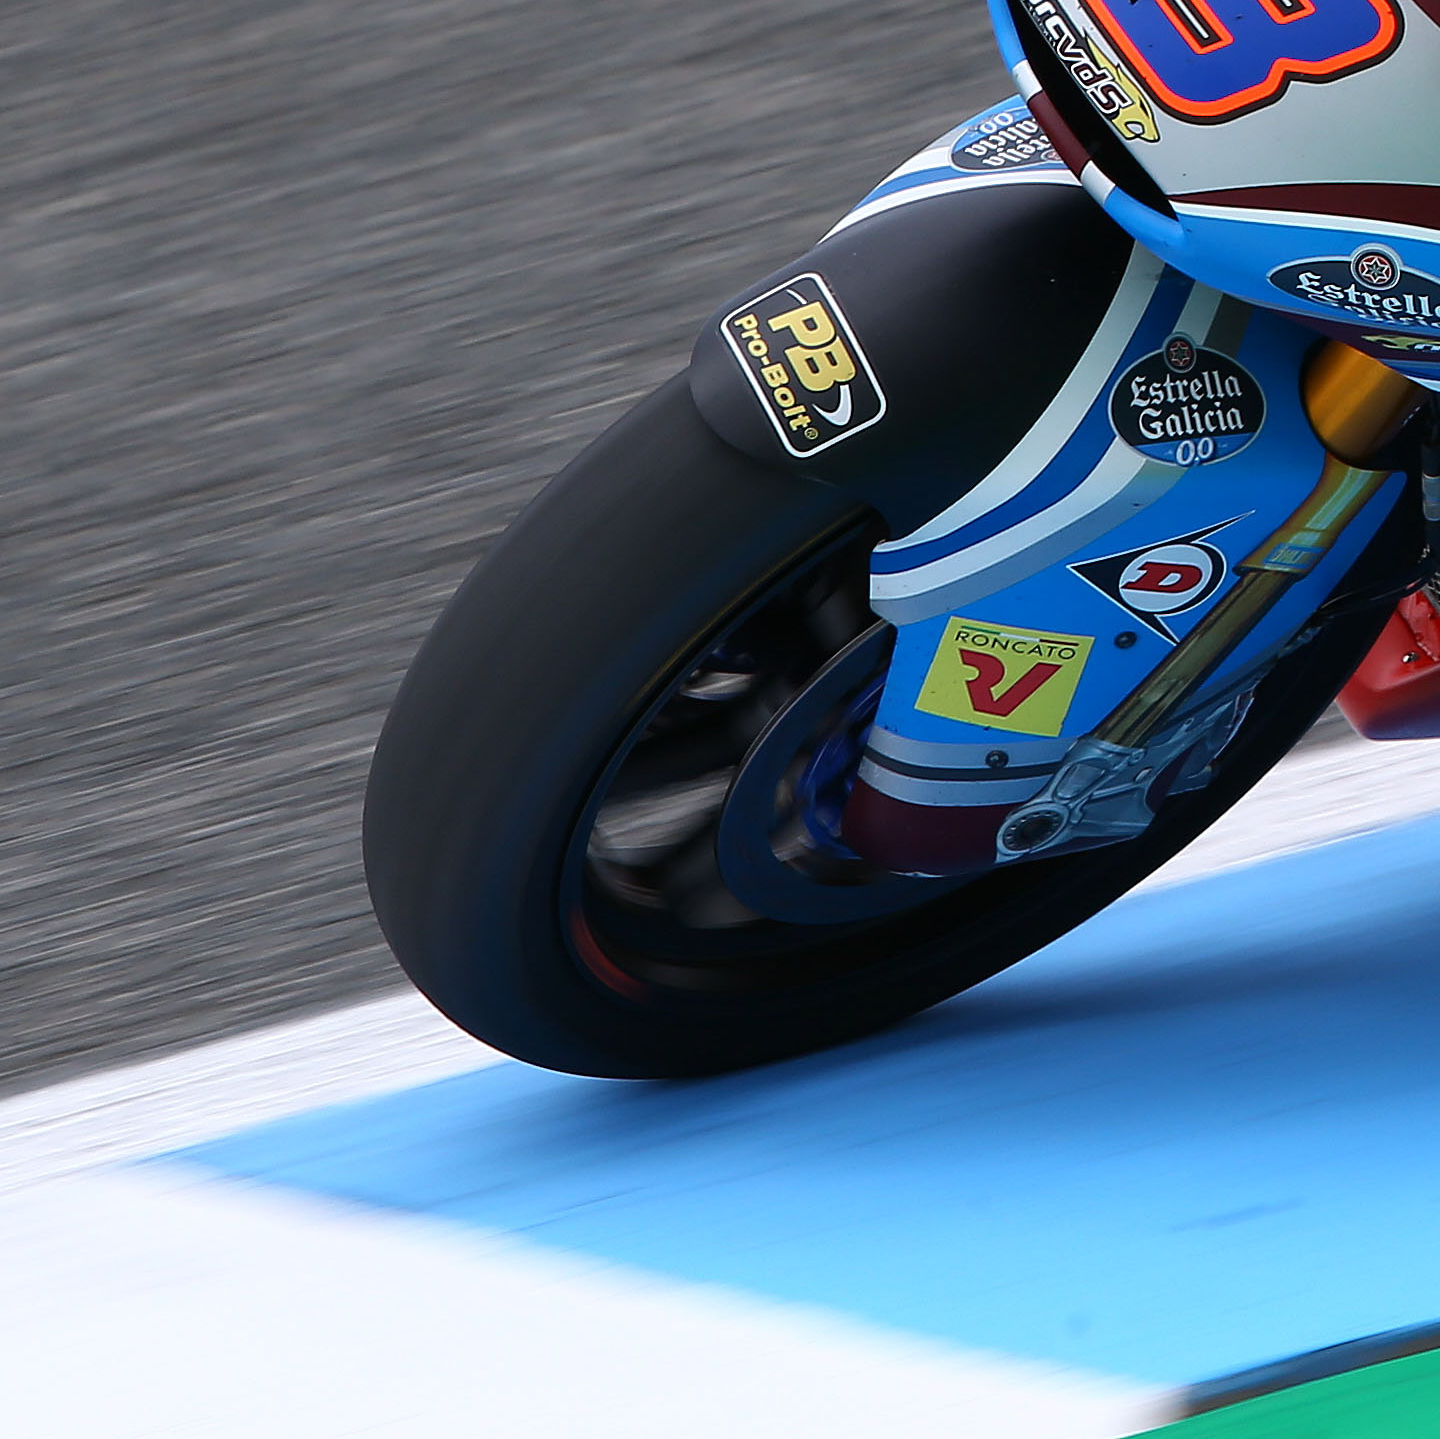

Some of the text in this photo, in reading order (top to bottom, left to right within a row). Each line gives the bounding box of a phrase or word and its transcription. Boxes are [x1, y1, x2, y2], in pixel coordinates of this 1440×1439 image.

[964, 119, 1039, 158] alicia
[767, 301, 857, 393] PB
[1130, 370, 1243, 408] Estrella
[1139, 401, 1245, 440] Galicia
[1119, 560, 1204, 596] D
[953, 628, 1078, 662] RONCATO
